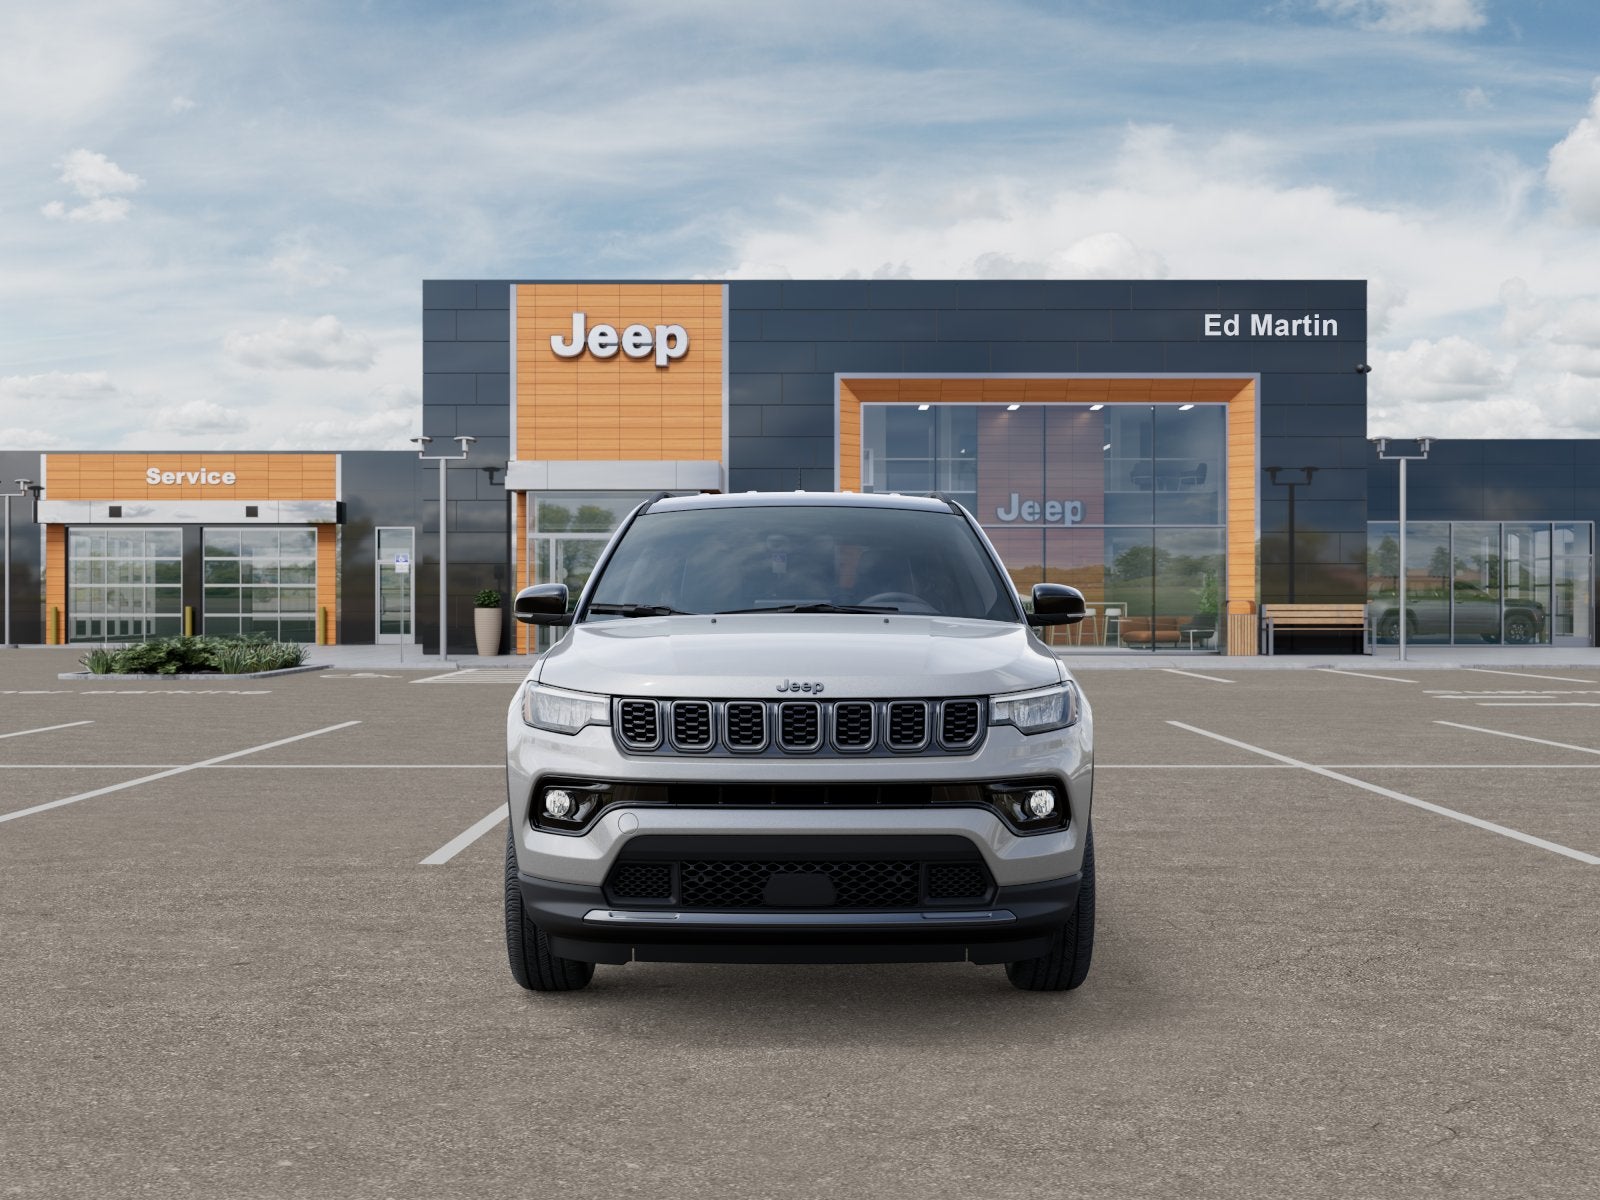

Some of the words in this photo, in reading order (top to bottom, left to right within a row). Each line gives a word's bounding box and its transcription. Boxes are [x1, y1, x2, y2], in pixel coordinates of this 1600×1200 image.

[1204, 313, 1240, 336] Ed
[1250, 313, 1338, 336] Martin
[550, 312, 690, 368] Jeep
[146, 467, 236, 486] Service
[996, 492, 1084, 526] Jeep
[776, 679, 824, 695] Jeep
